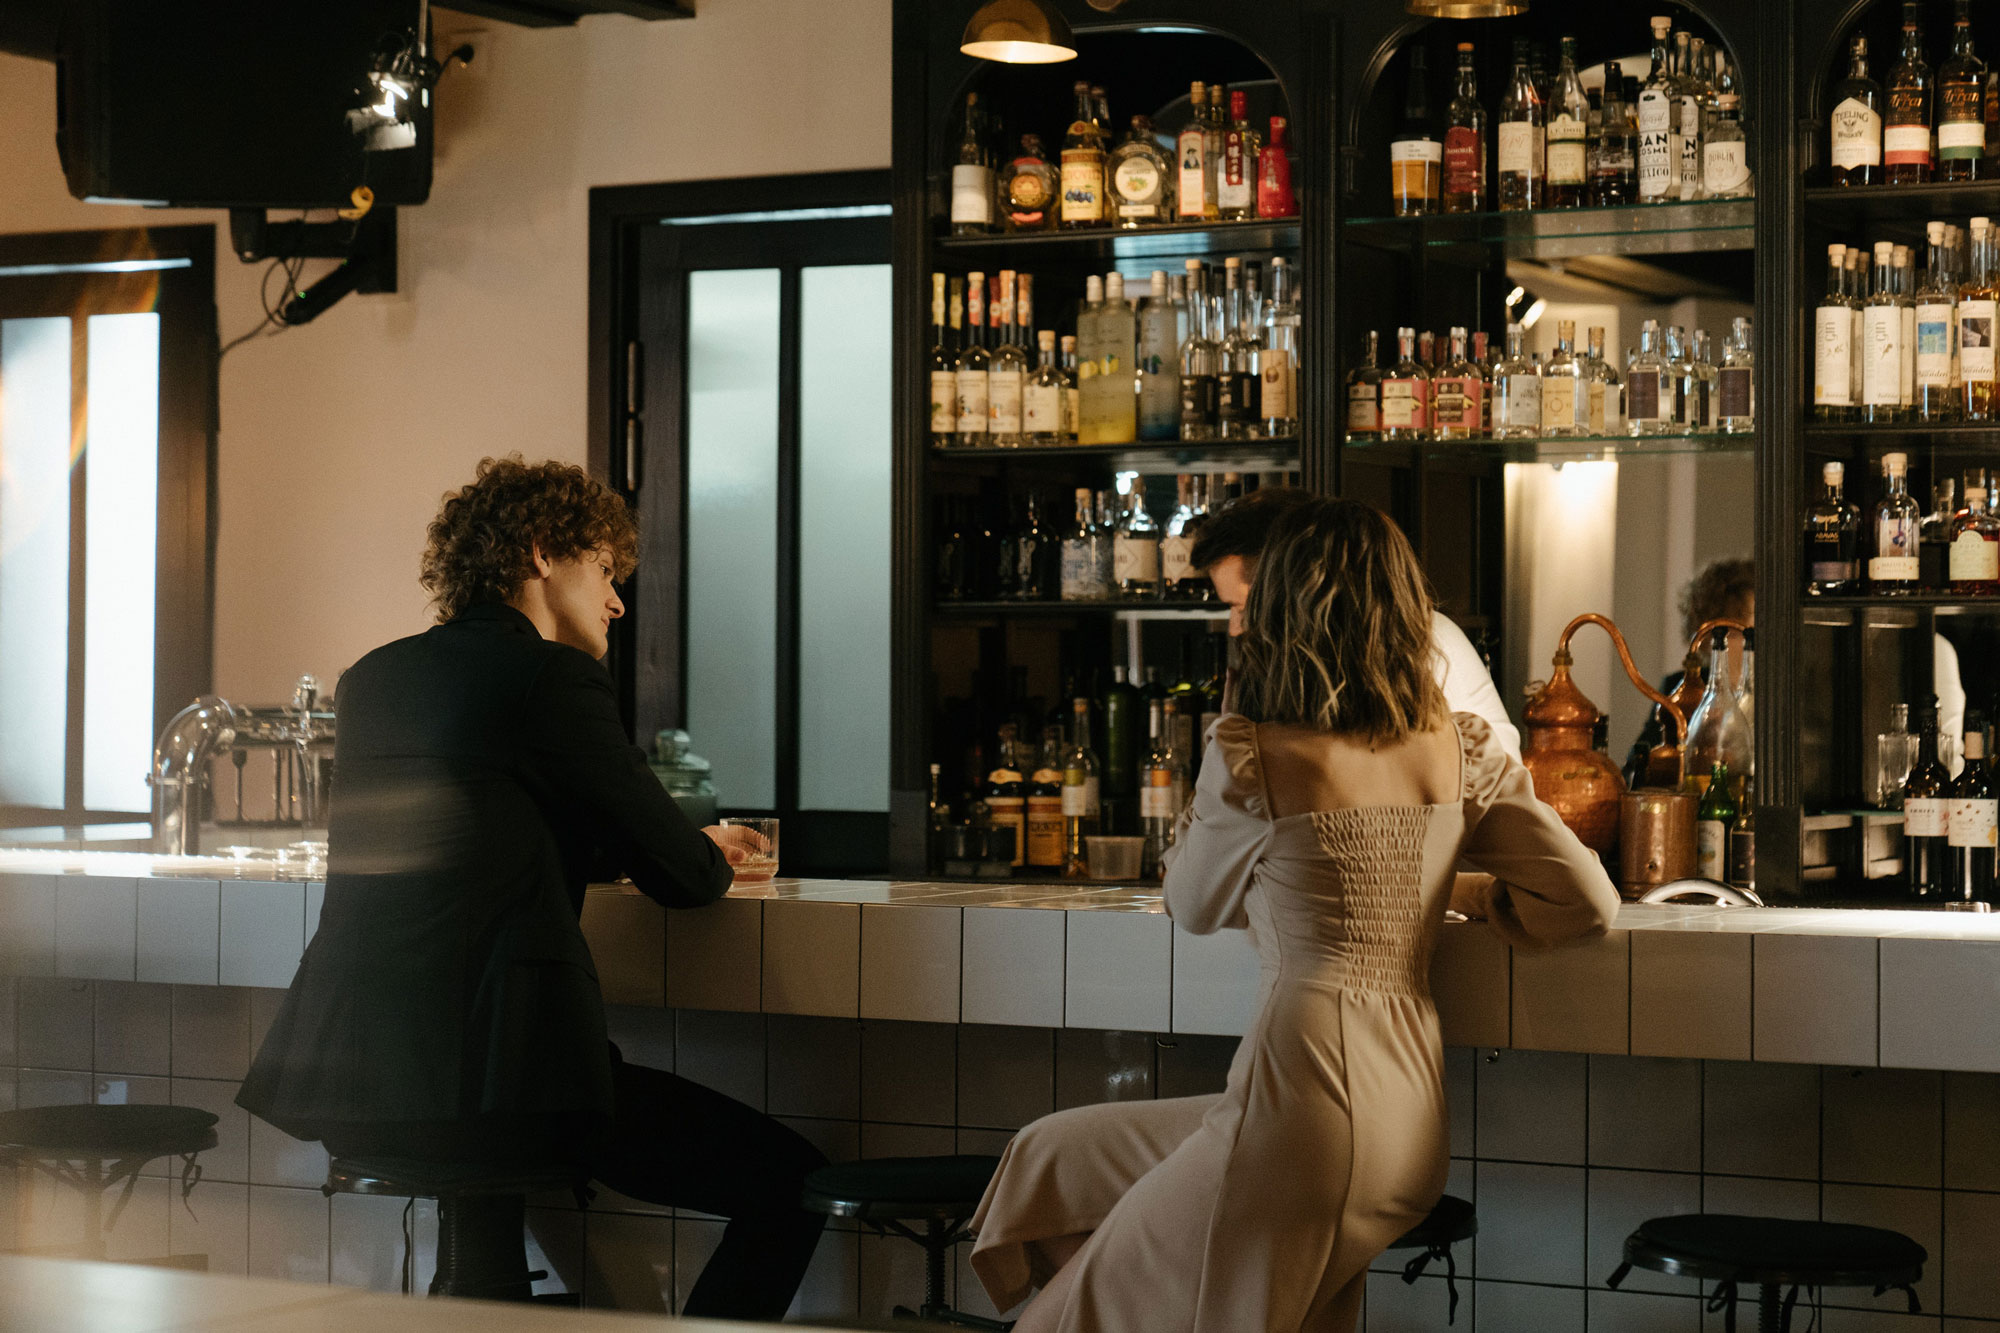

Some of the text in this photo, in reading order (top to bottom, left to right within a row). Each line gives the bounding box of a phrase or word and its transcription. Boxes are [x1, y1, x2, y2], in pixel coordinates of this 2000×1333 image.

[1890, 93, 1923, 107] Arran
[1944, 89, 1979, 103] Arran
[1835, 111, 1869, 123] TEELING
[1837, 129, 1863, 139] WHISKEY
[1640, 147, 1669, 156] OSME
[1640, 168, 1669, 179] EXICO
